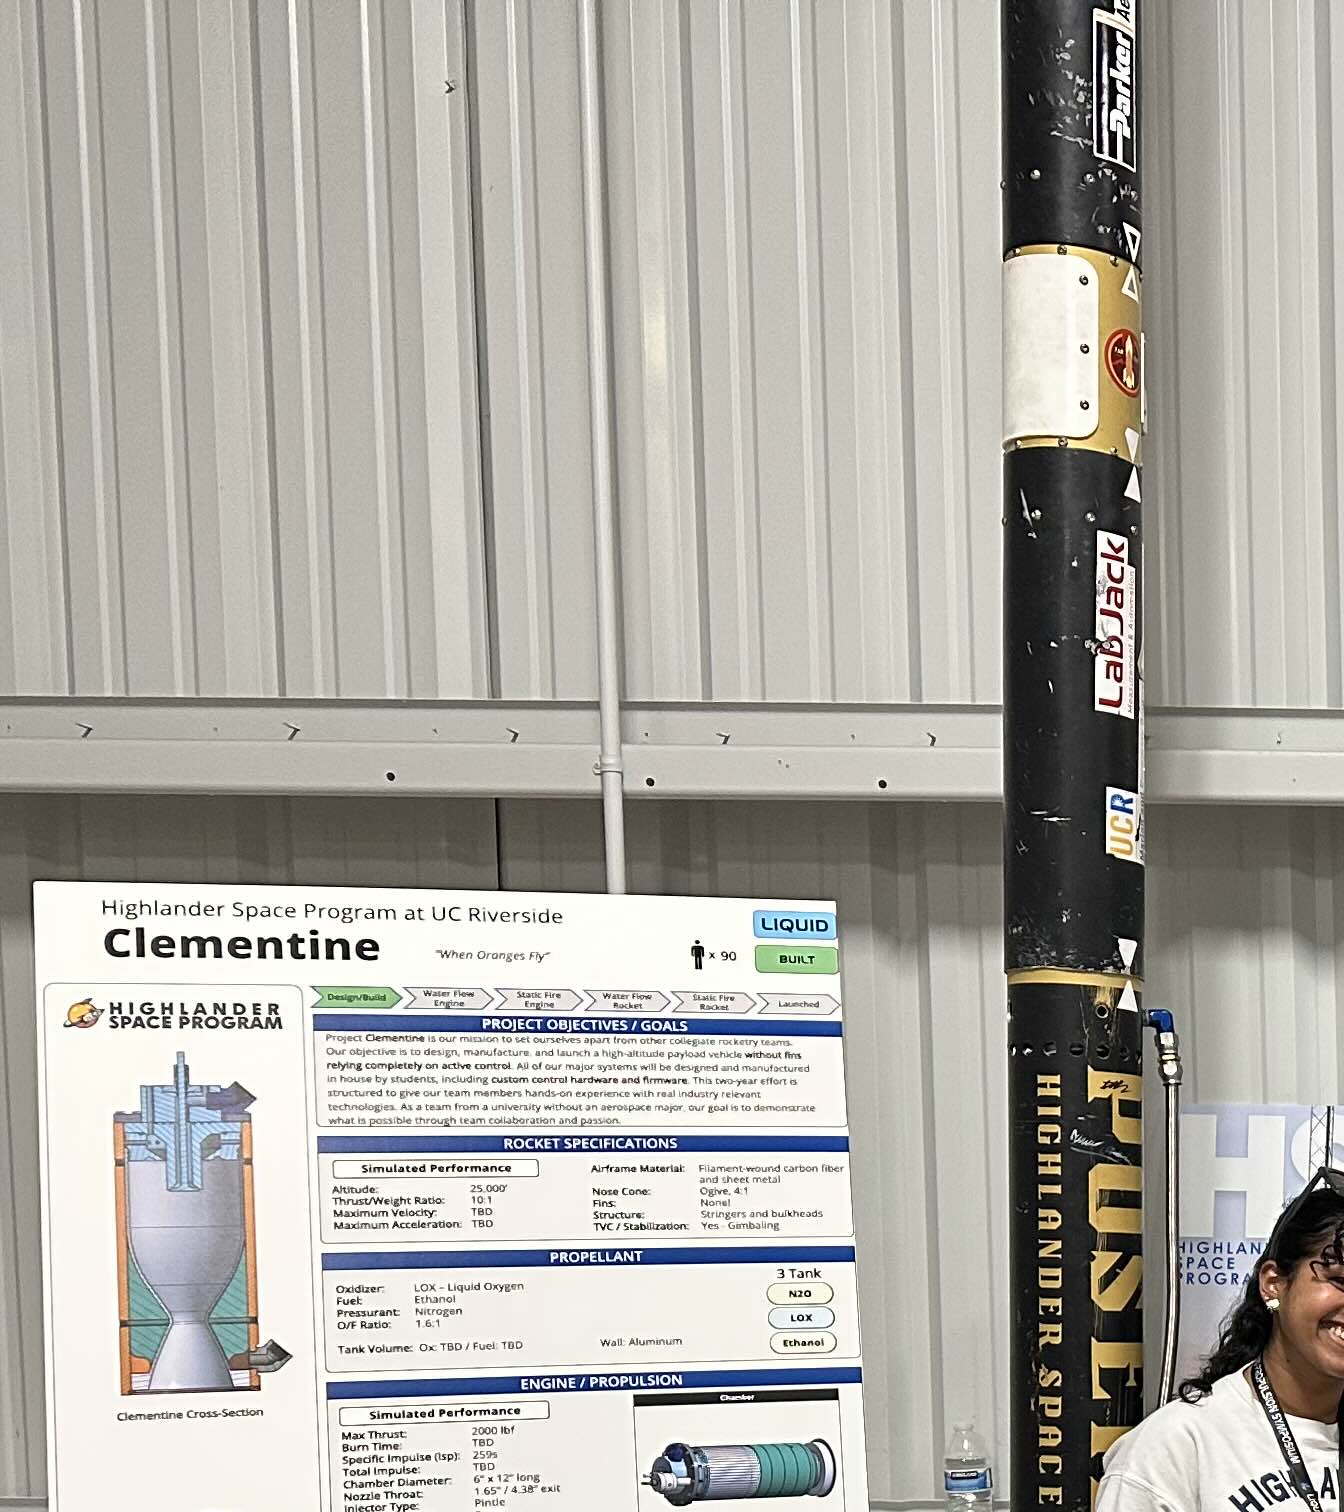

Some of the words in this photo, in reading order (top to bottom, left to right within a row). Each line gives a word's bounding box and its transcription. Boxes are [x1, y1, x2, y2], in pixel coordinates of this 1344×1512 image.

[1109, 30, 1131, 161] Parker
[1098, 537, 1125, 709] LabJack
[1110, 793, 1134, 856] UCR
[102, 900, 224, 919] Highlander
[233, 902, 295, 921] Space
[305, 903, 396, 923] Program
[404, 908, 424, 920] at
[432, 906, 460, 921] UC
[469, 907, 562, 923] Riverside
[761, 918, 829, 934] LIQUID
[104, 927, 379, 961] Clementine
[708, 951, 715, 959] x
[721, 951, 736, 961] 90
[779, 955, 815, 964] BUILT
[327, 992, 387, 1004] Design/Build
[109, 1002, 283, 1015] HIGHLANDER
[109, 1016, 171, 1028] SPACE
[179, 1016, 282, 1029] PROGRAM
[482, 1018, 543, 1033] PROJECT
[546, 1017, 628, 1033] OBJECTIVES
[631, 1017, 637, 1030] /
[640, 1018, 689, 1034] GOALS
[504, 1138, 560, 1149] ROCKET
[565, 1138, 679, 1153] SPECIFICATIONS
[361, 1164, 426, 1173] Simulated
[430, 1164, 511, 1172] Performance
[1036, 1073, 1064, 1347] HIGHLANDER
[550, 1250, 643, 1263] PROPELLANT
[777, 1268, 784, 1278] 3
[788, 1268, 821, 1278] Tank
[790, 1314, 812, 1322] LOX
[783, 1338, 824, 1347] Ethanol
[521, 1377, 576, 1390] ENGINE
[580, 1377, 585, 1388] /
[590, 1374, 682, 1387] PROPULSION
[117, 1411, 183, 1421] Clementine
[186, 1408, 263, 1418] Cross-Section
[369, 1409, 434, 1420] Simulated
[439, 1408, 520, 1417] Performance
[1037, 1363, 1064, 1505] SPACE
